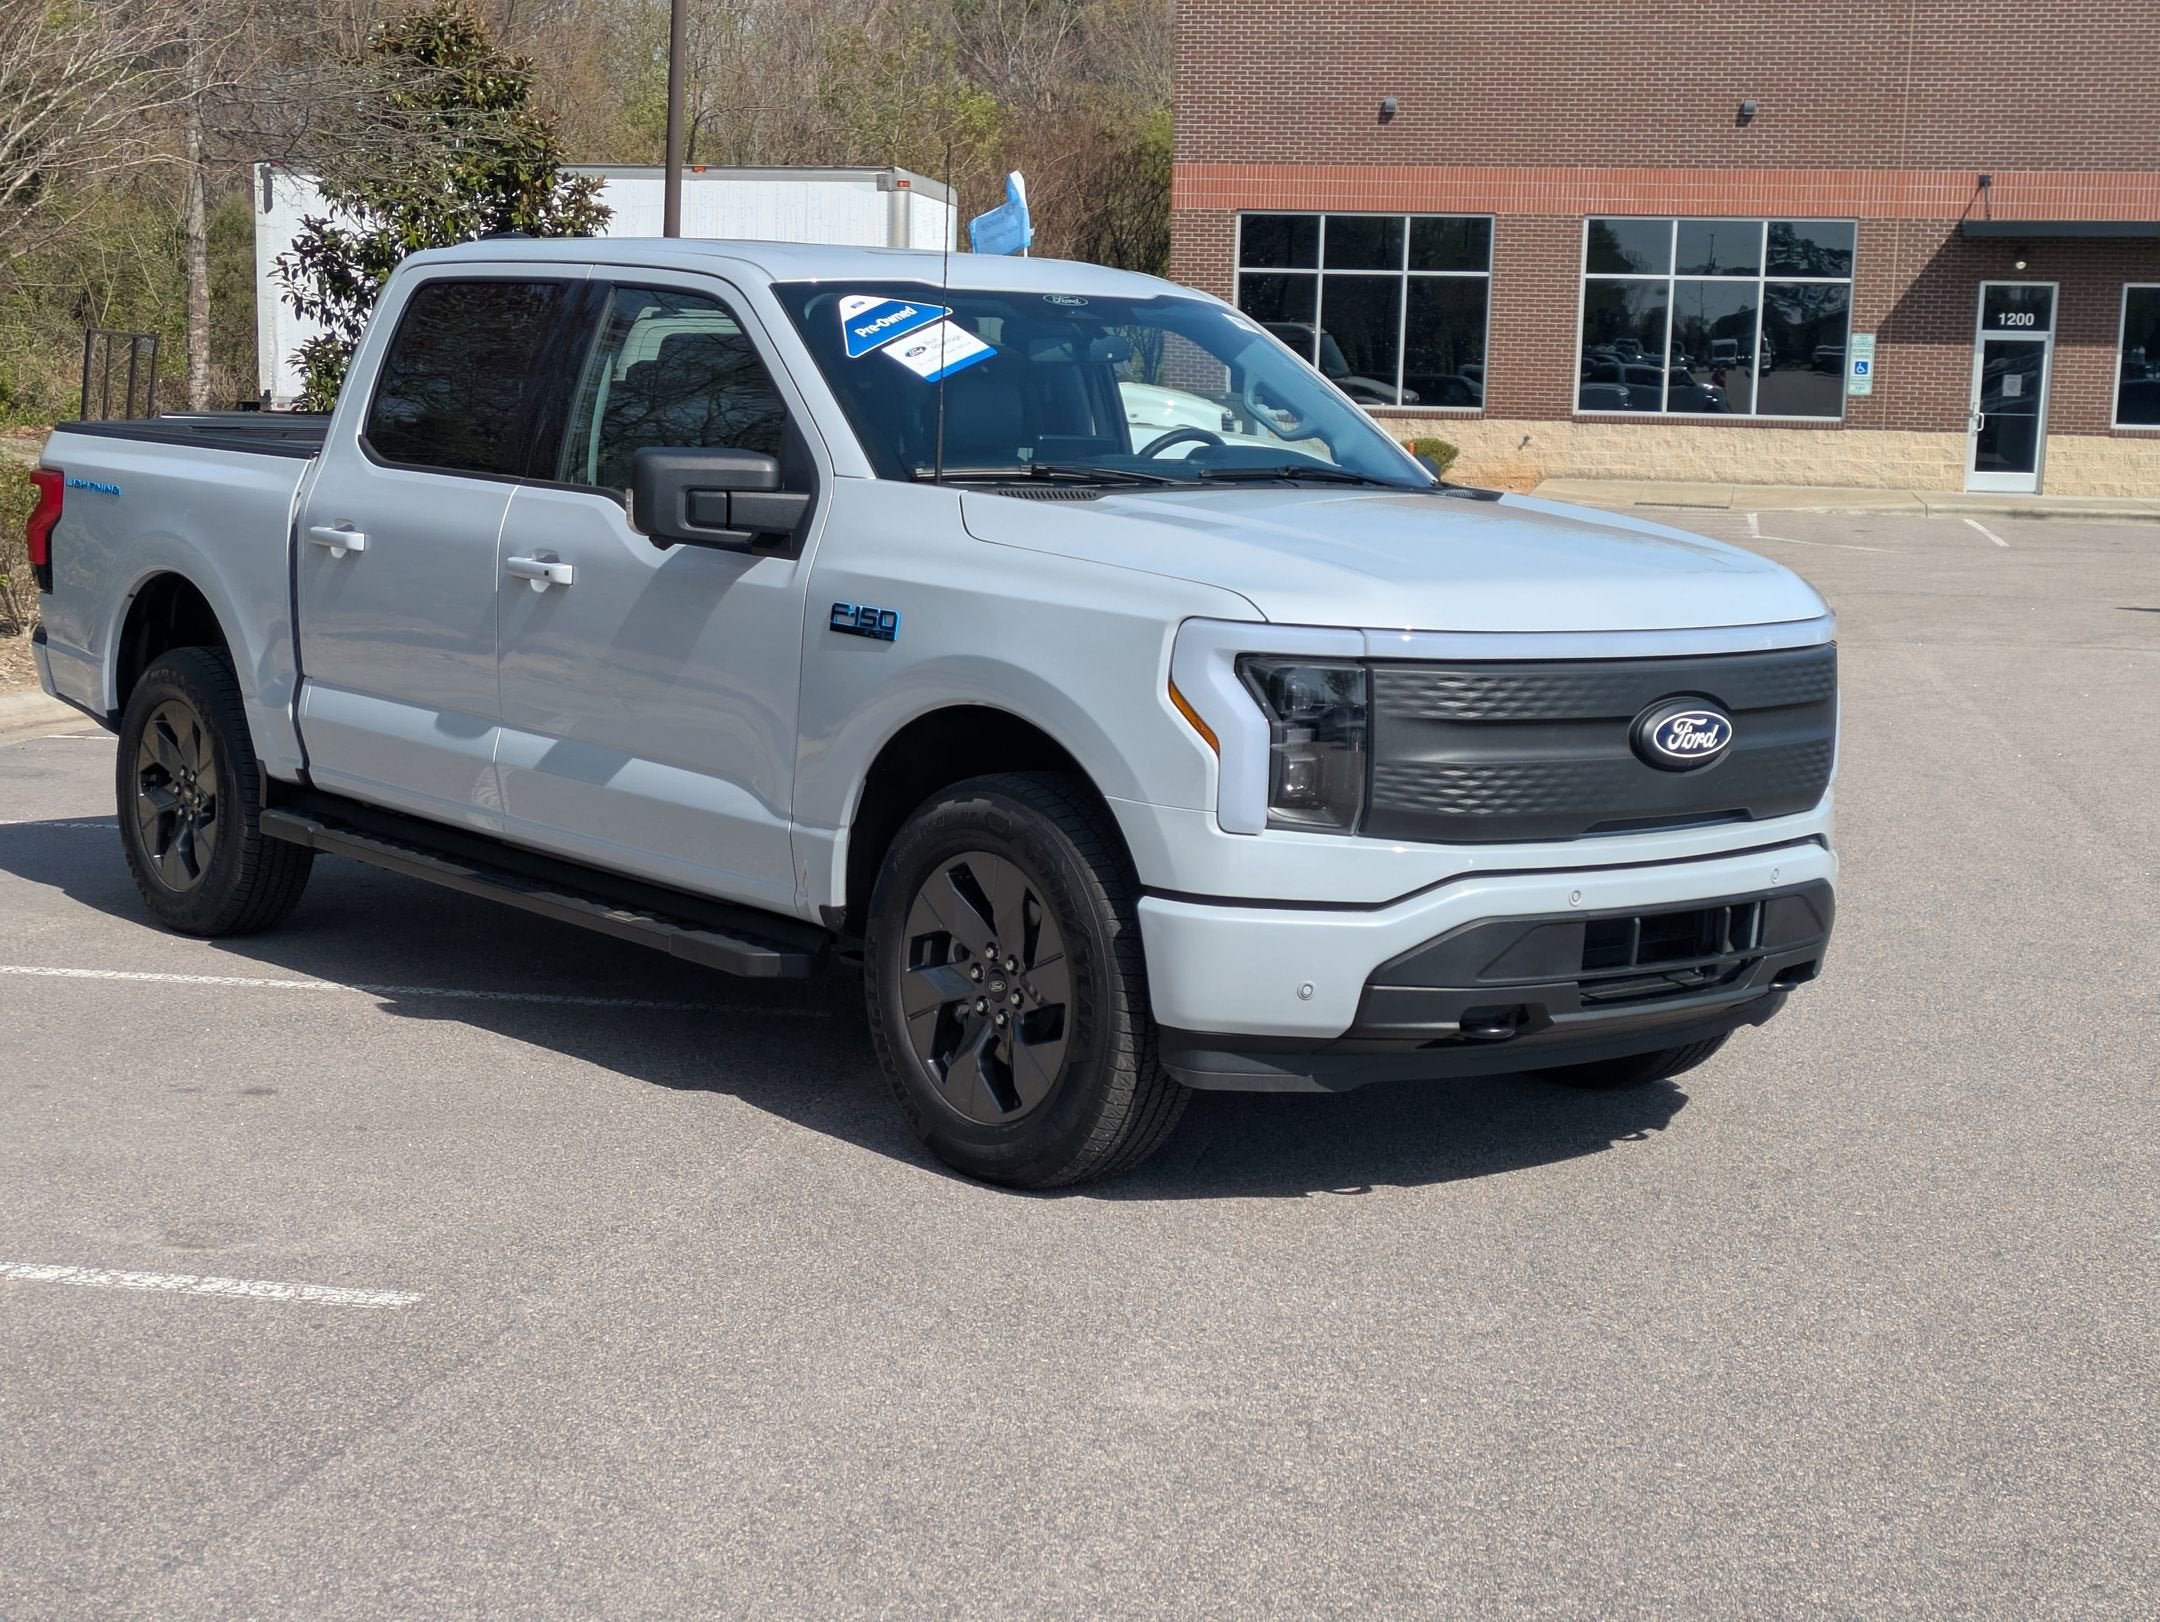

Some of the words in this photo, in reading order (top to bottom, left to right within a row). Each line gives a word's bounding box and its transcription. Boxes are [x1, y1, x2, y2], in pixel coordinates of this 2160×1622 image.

[1051, 295, 1083, 305] Ford
[854, 305, 918, 338] Pre-Owned
[1998, 312, 2035, 326] 1200
[66, 478, 122, 496] LIGHTNING
[830, 601, 900, 640] F-150
[1667, 717, 1720, 750] Ford
